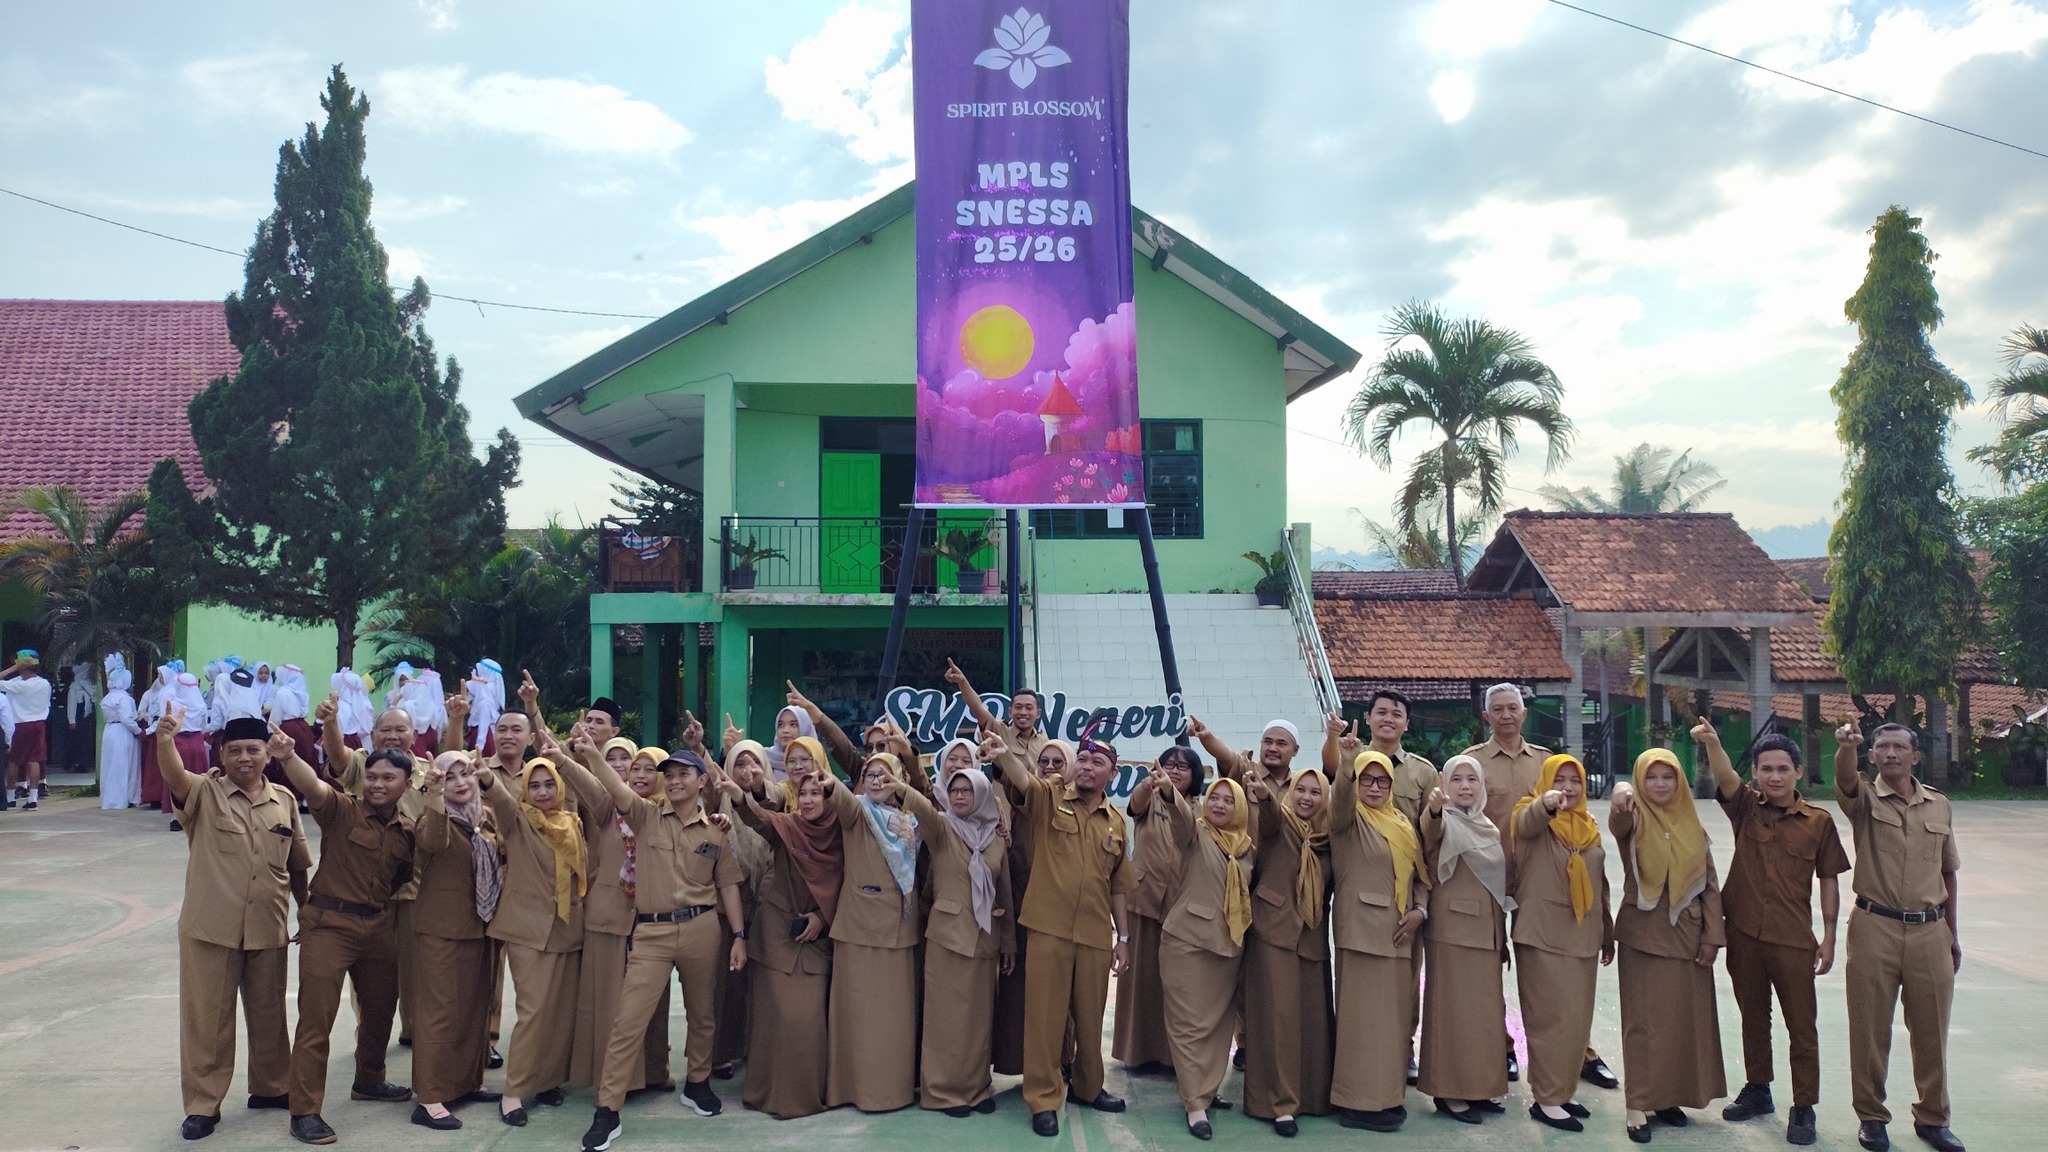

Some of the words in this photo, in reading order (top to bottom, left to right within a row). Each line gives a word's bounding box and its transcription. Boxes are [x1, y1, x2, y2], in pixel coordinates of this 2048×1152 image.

[947, 102, 1007, 119] SPIRIT
[1012, 101, 1101, 118] BLOSSOM
[978, 161, 1069, 189] MPLS
[956, 199, 1093, 227] SNESSA
[974, 235, 1076, 263] 25/26
